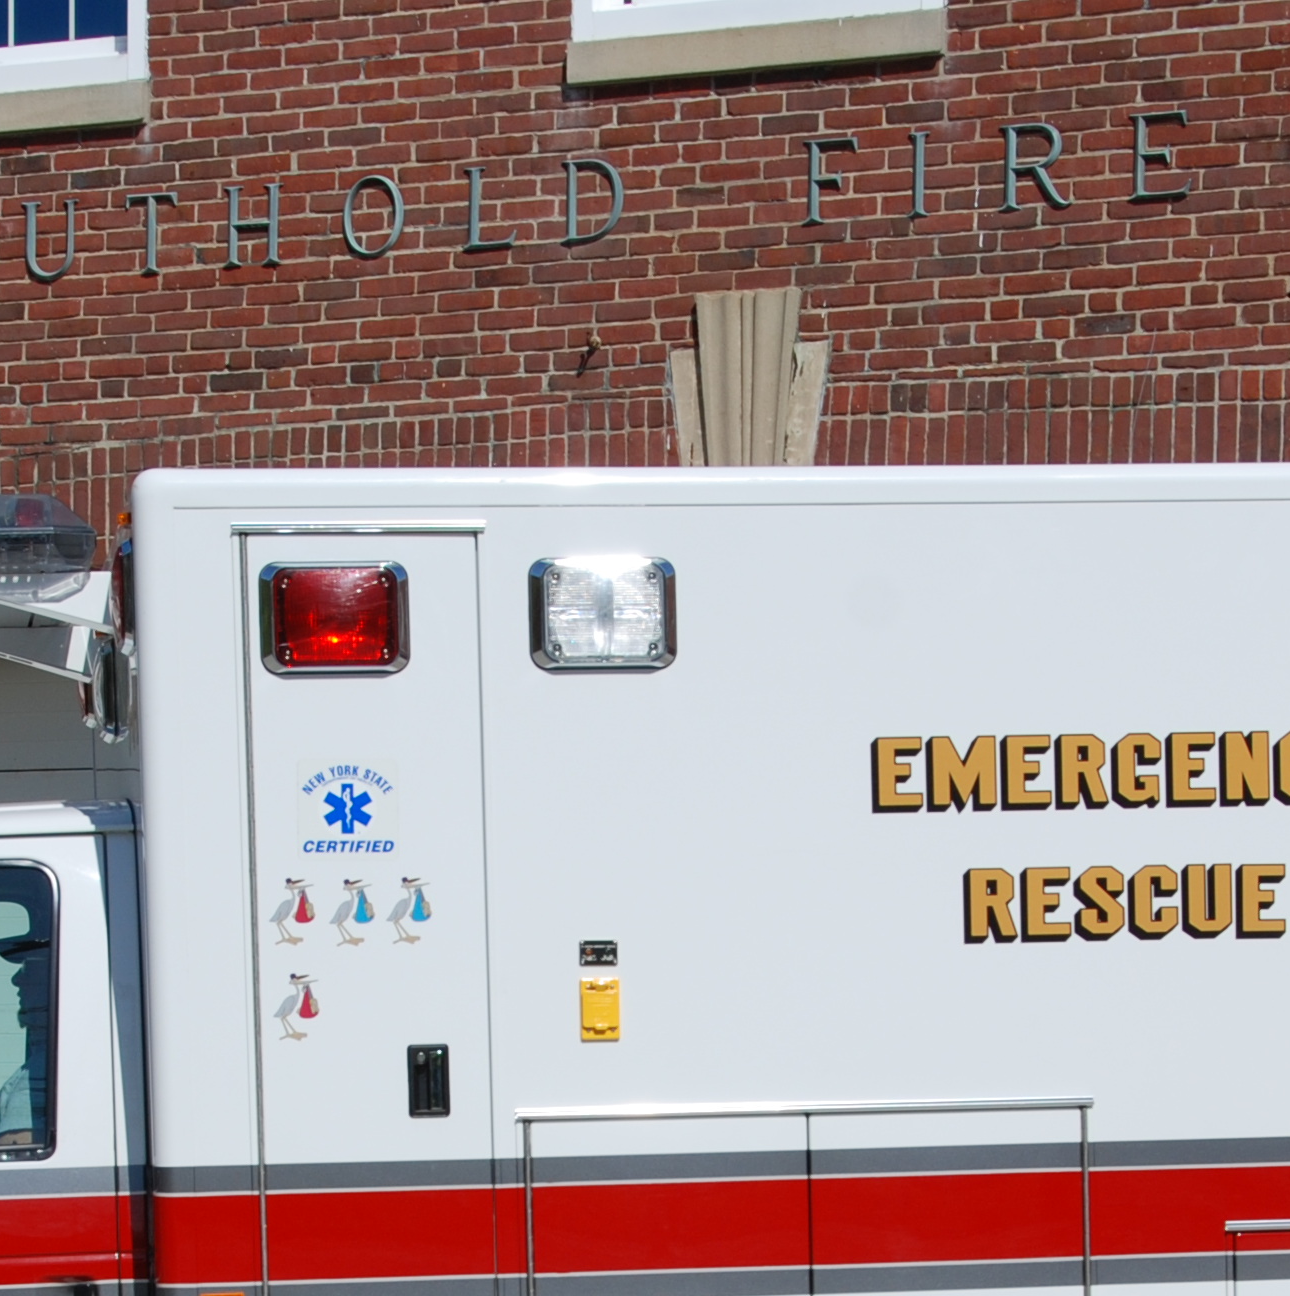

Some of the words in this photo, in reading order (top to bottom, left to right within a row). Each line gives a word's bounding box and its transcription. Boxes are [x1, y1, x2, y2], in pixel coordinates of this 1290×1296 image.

[802, 108, 1193, 228] FIRE
[301, 771, 326, 796] NEW
[328, 764, 359, 778] YORK
[362, 768, 395, 795] STATE
[302, 839, 395, 854] CERTIFIED
[962, 863, 1287, 944] RESCUE
